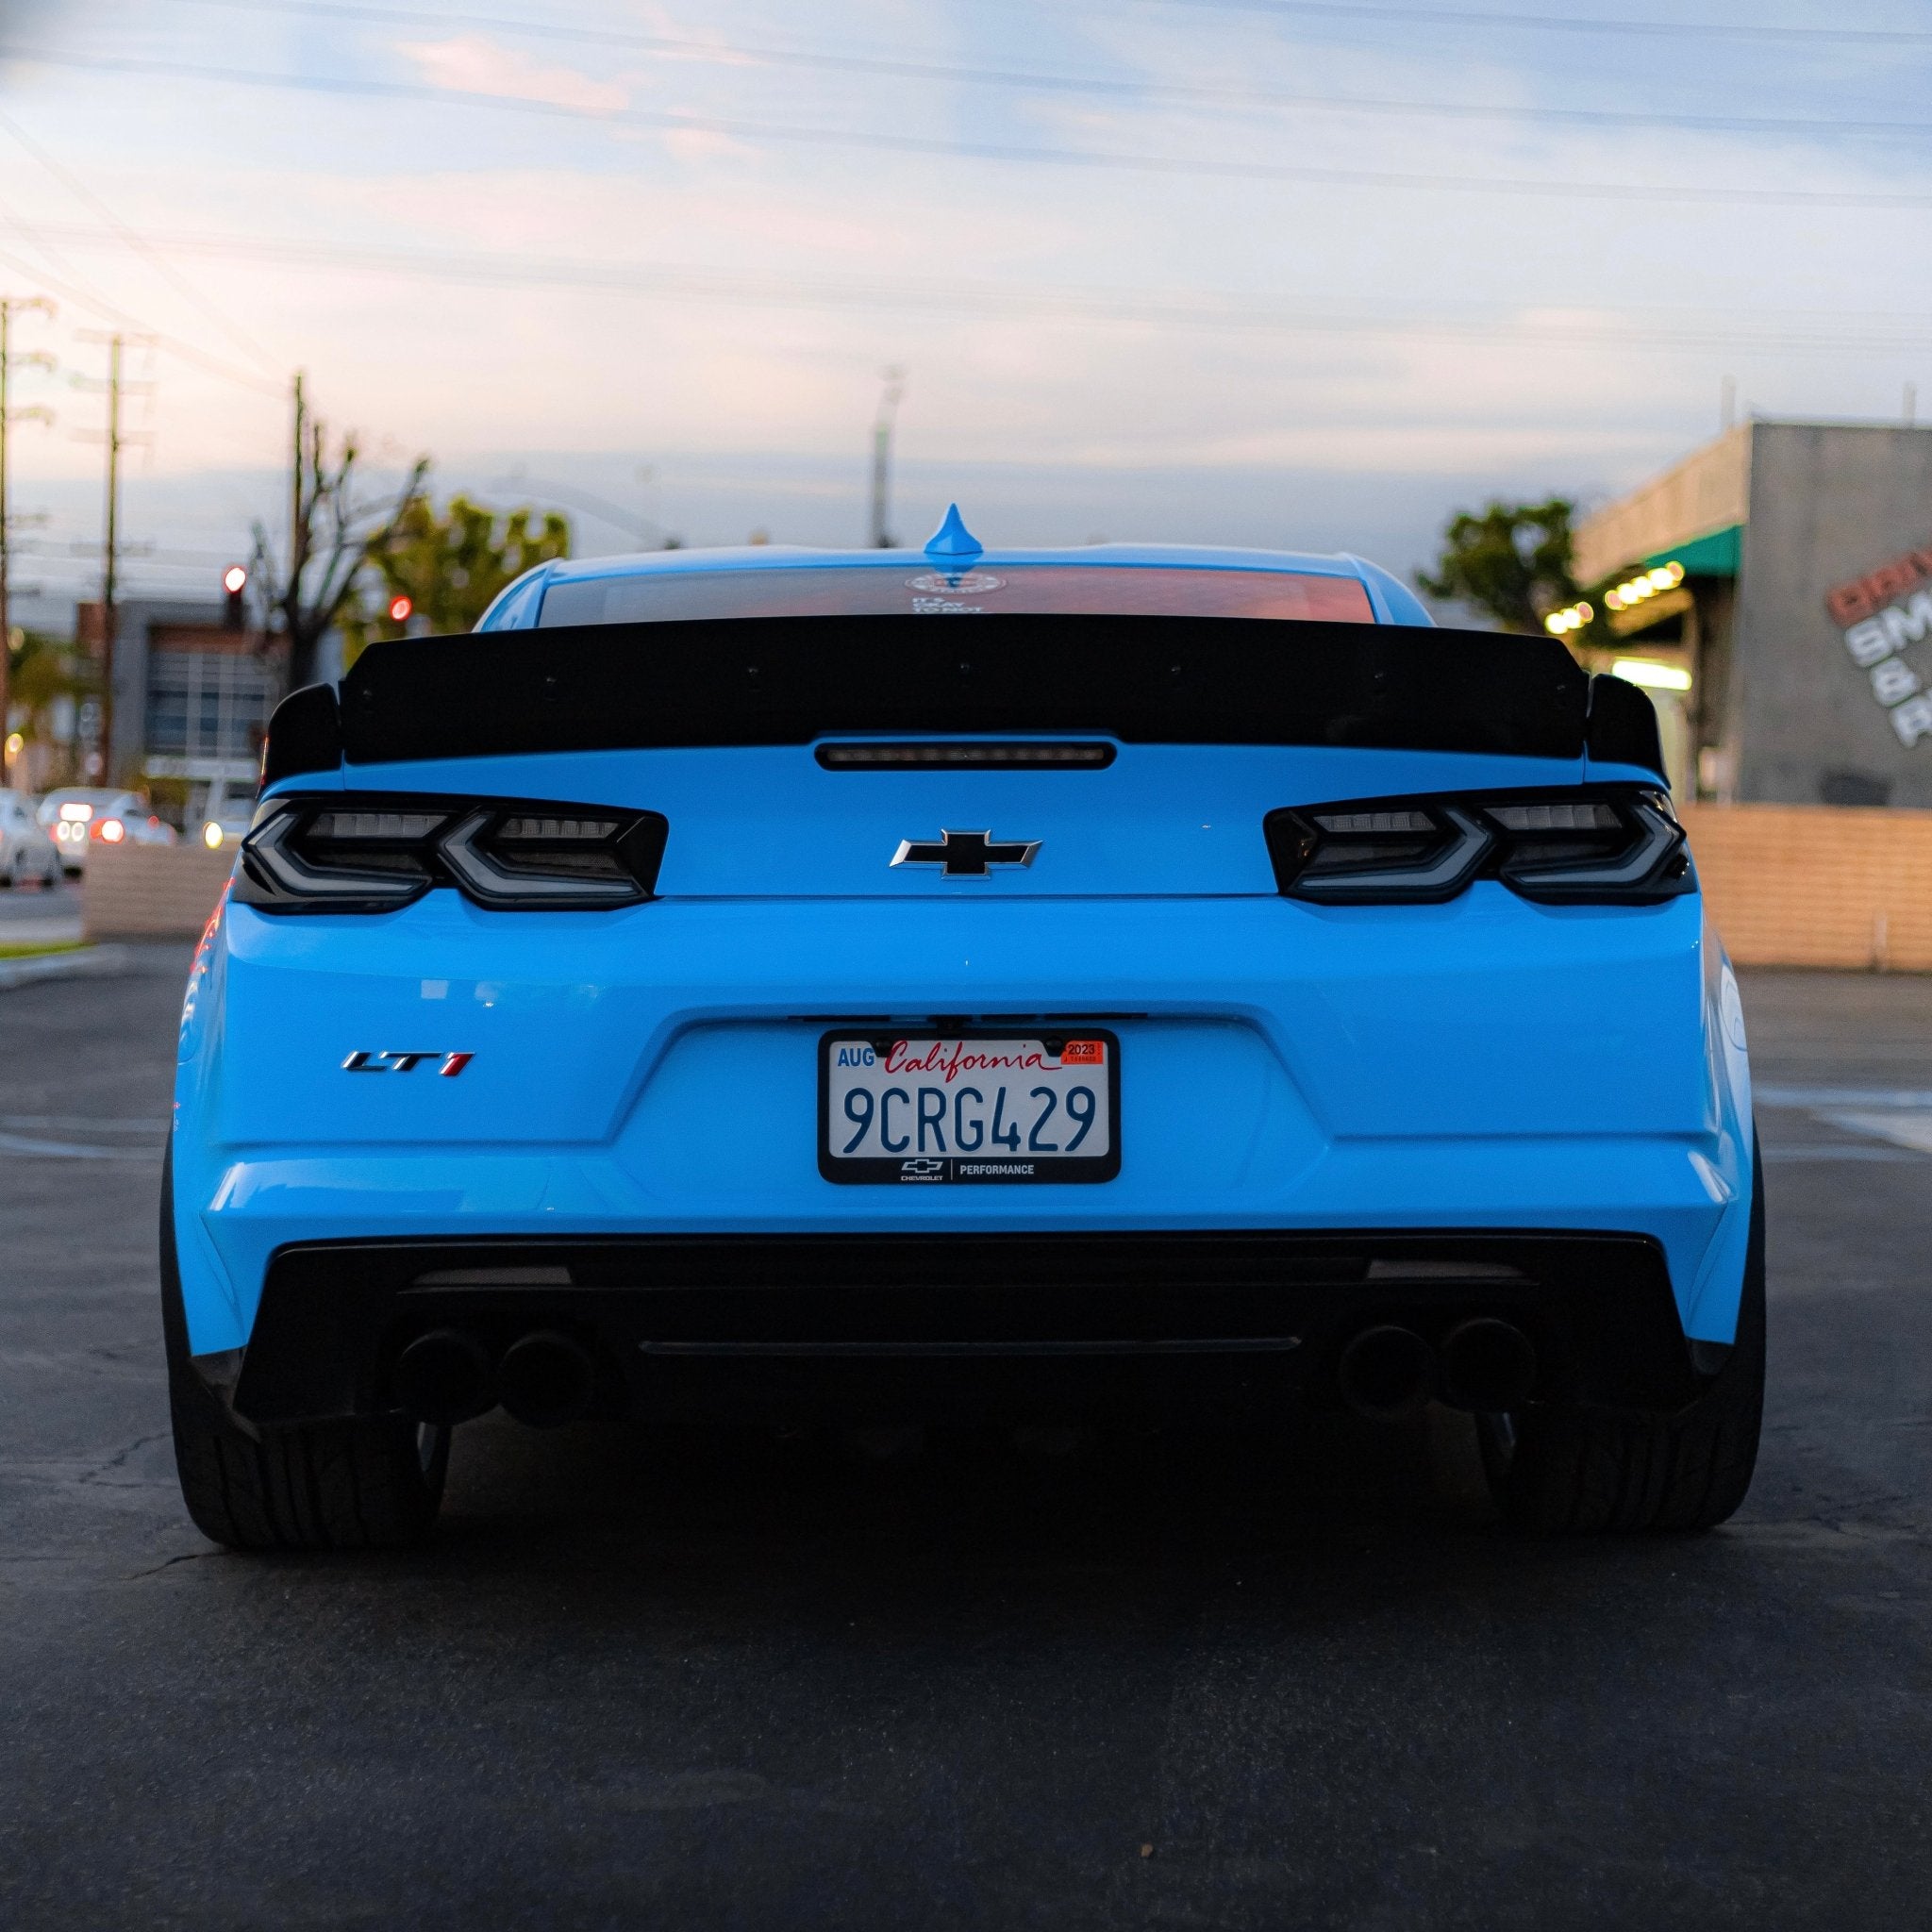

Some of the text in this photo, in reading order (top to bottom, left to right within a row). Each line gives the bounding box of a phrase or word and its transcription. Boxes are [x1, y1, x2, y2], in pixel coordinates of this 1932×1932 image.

[838, 1048, 874, 1067] AUG
[884, 1041, 1062, 1083] California
[1068, 1044, 1095, 1055] 2023
[341, 1051, 475, 1076] LT1
[843, 1086, 1096, 1153] 9CRG429
[959, 1164, 1035, 1175] PERFORMANCE
